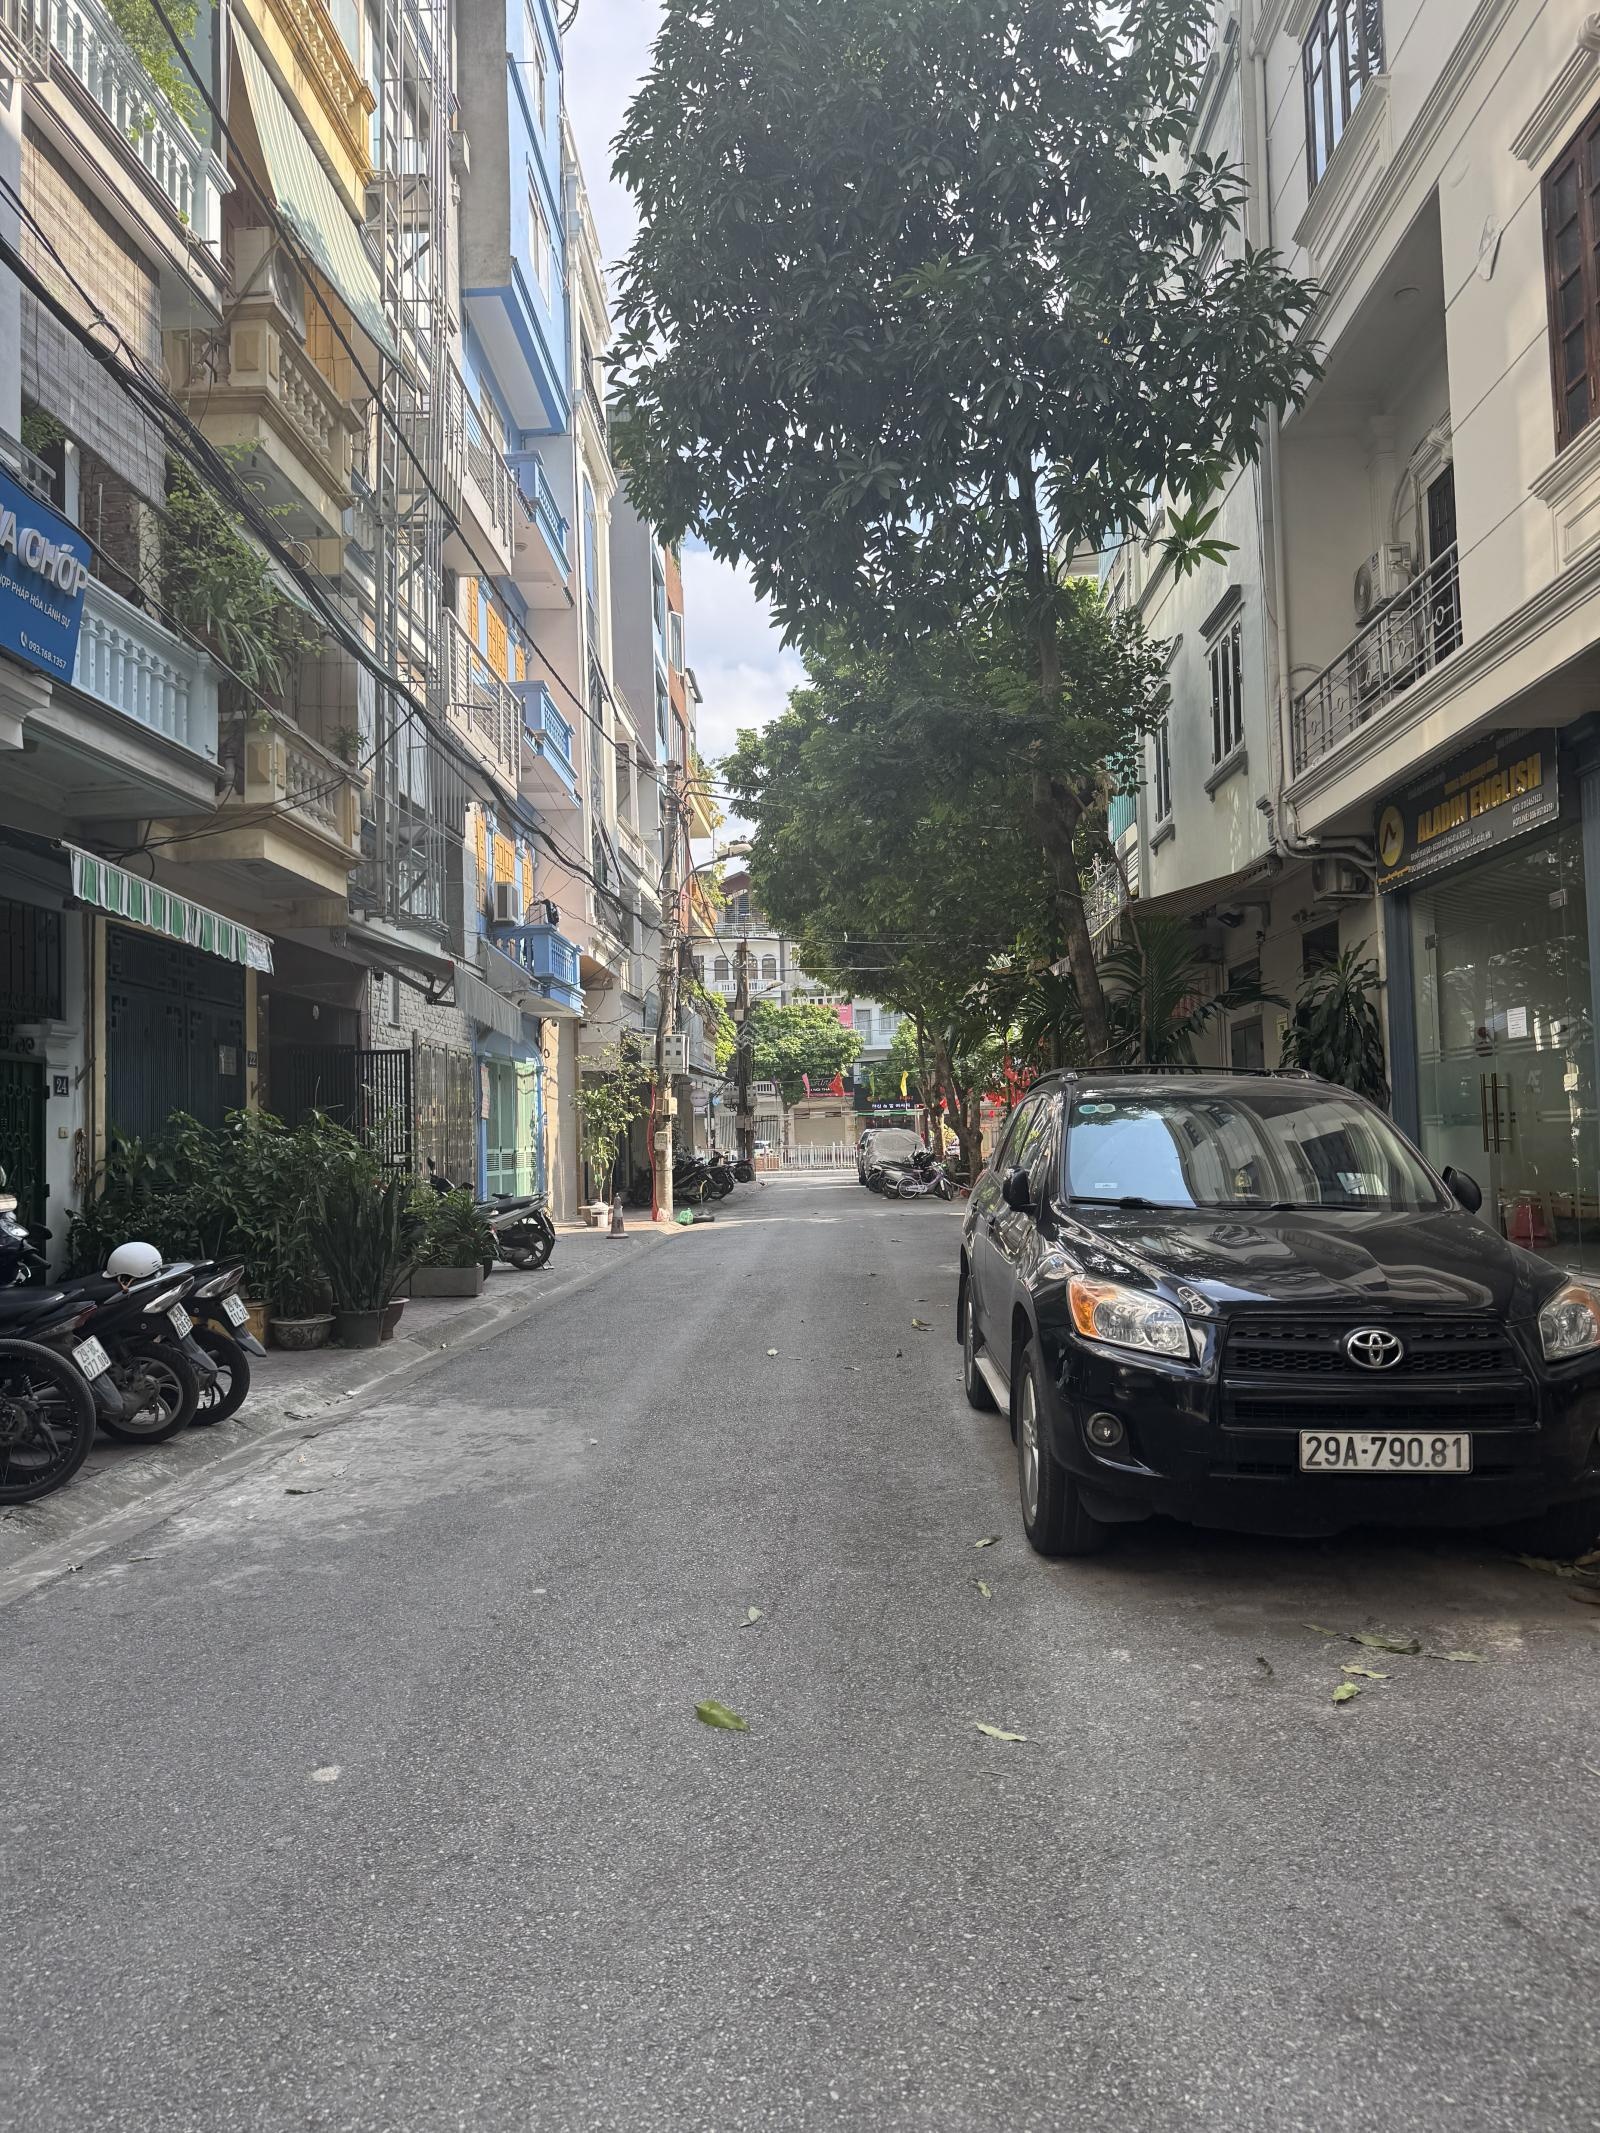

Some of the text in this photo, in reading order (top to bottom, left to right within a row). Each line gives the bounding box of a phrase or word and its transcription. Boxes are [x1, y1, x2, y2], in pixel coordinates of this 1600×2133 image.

[19, 528, 88, 597] CHỚP
[11, 581, 30, 601] PHÁP
[44, 603, 61, 623] LÃNH
[61, 614, 71, 629] SỰ
[28, 640, 67, 670] 093.168.1357
[1417, 792, 1468, 844] ALADIN
[1471, 752, 1542, 818] ENGLISH
[248, 1054, 257, 1066] 22
[56, 1077, 68, 1094] 24
[83, 1352, 110, 1378] 077.08
[1305, 1436, 1462, 1468] 29A-790.81
